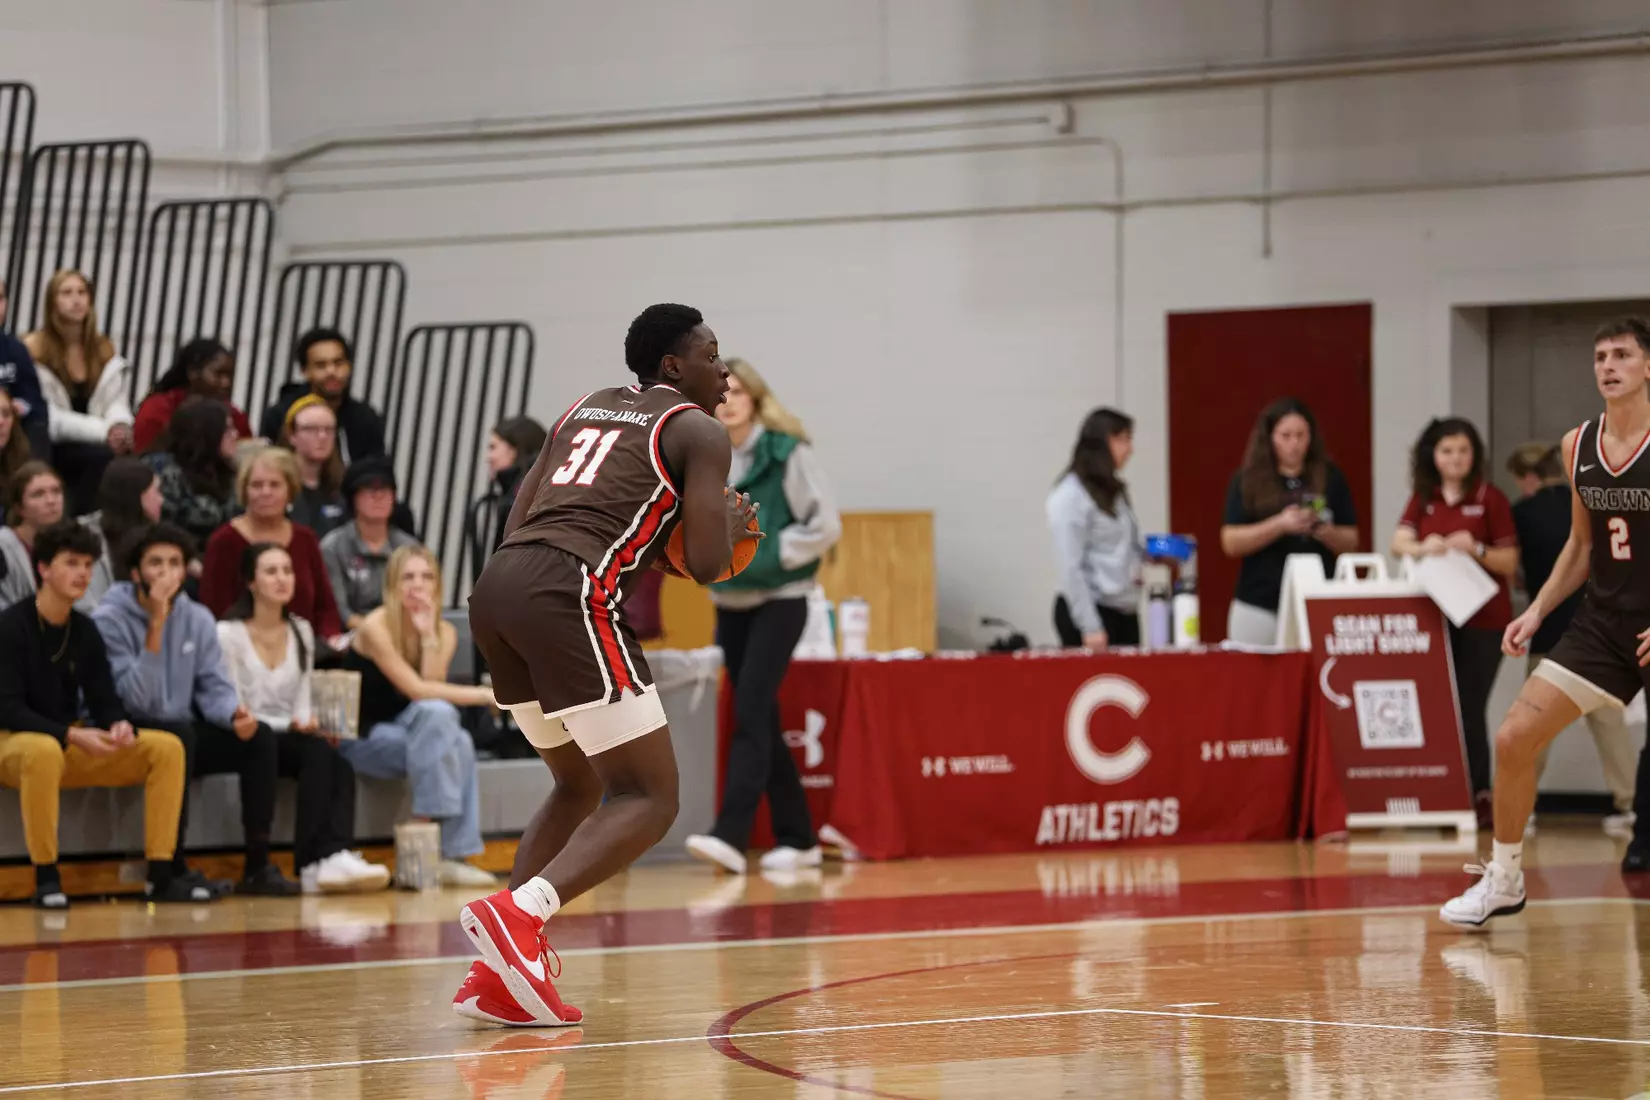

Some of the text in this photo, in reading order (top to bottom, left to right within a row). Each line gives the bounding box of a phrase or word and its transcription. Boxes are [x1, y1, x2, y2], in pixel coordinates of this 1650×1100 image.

[551, 427, 623, 486] 31
[1608, 517, 1631, 560] 2
[1064, 673, 1152, 785] C
[1035, 797, 1180, 845] ATHLETICS
